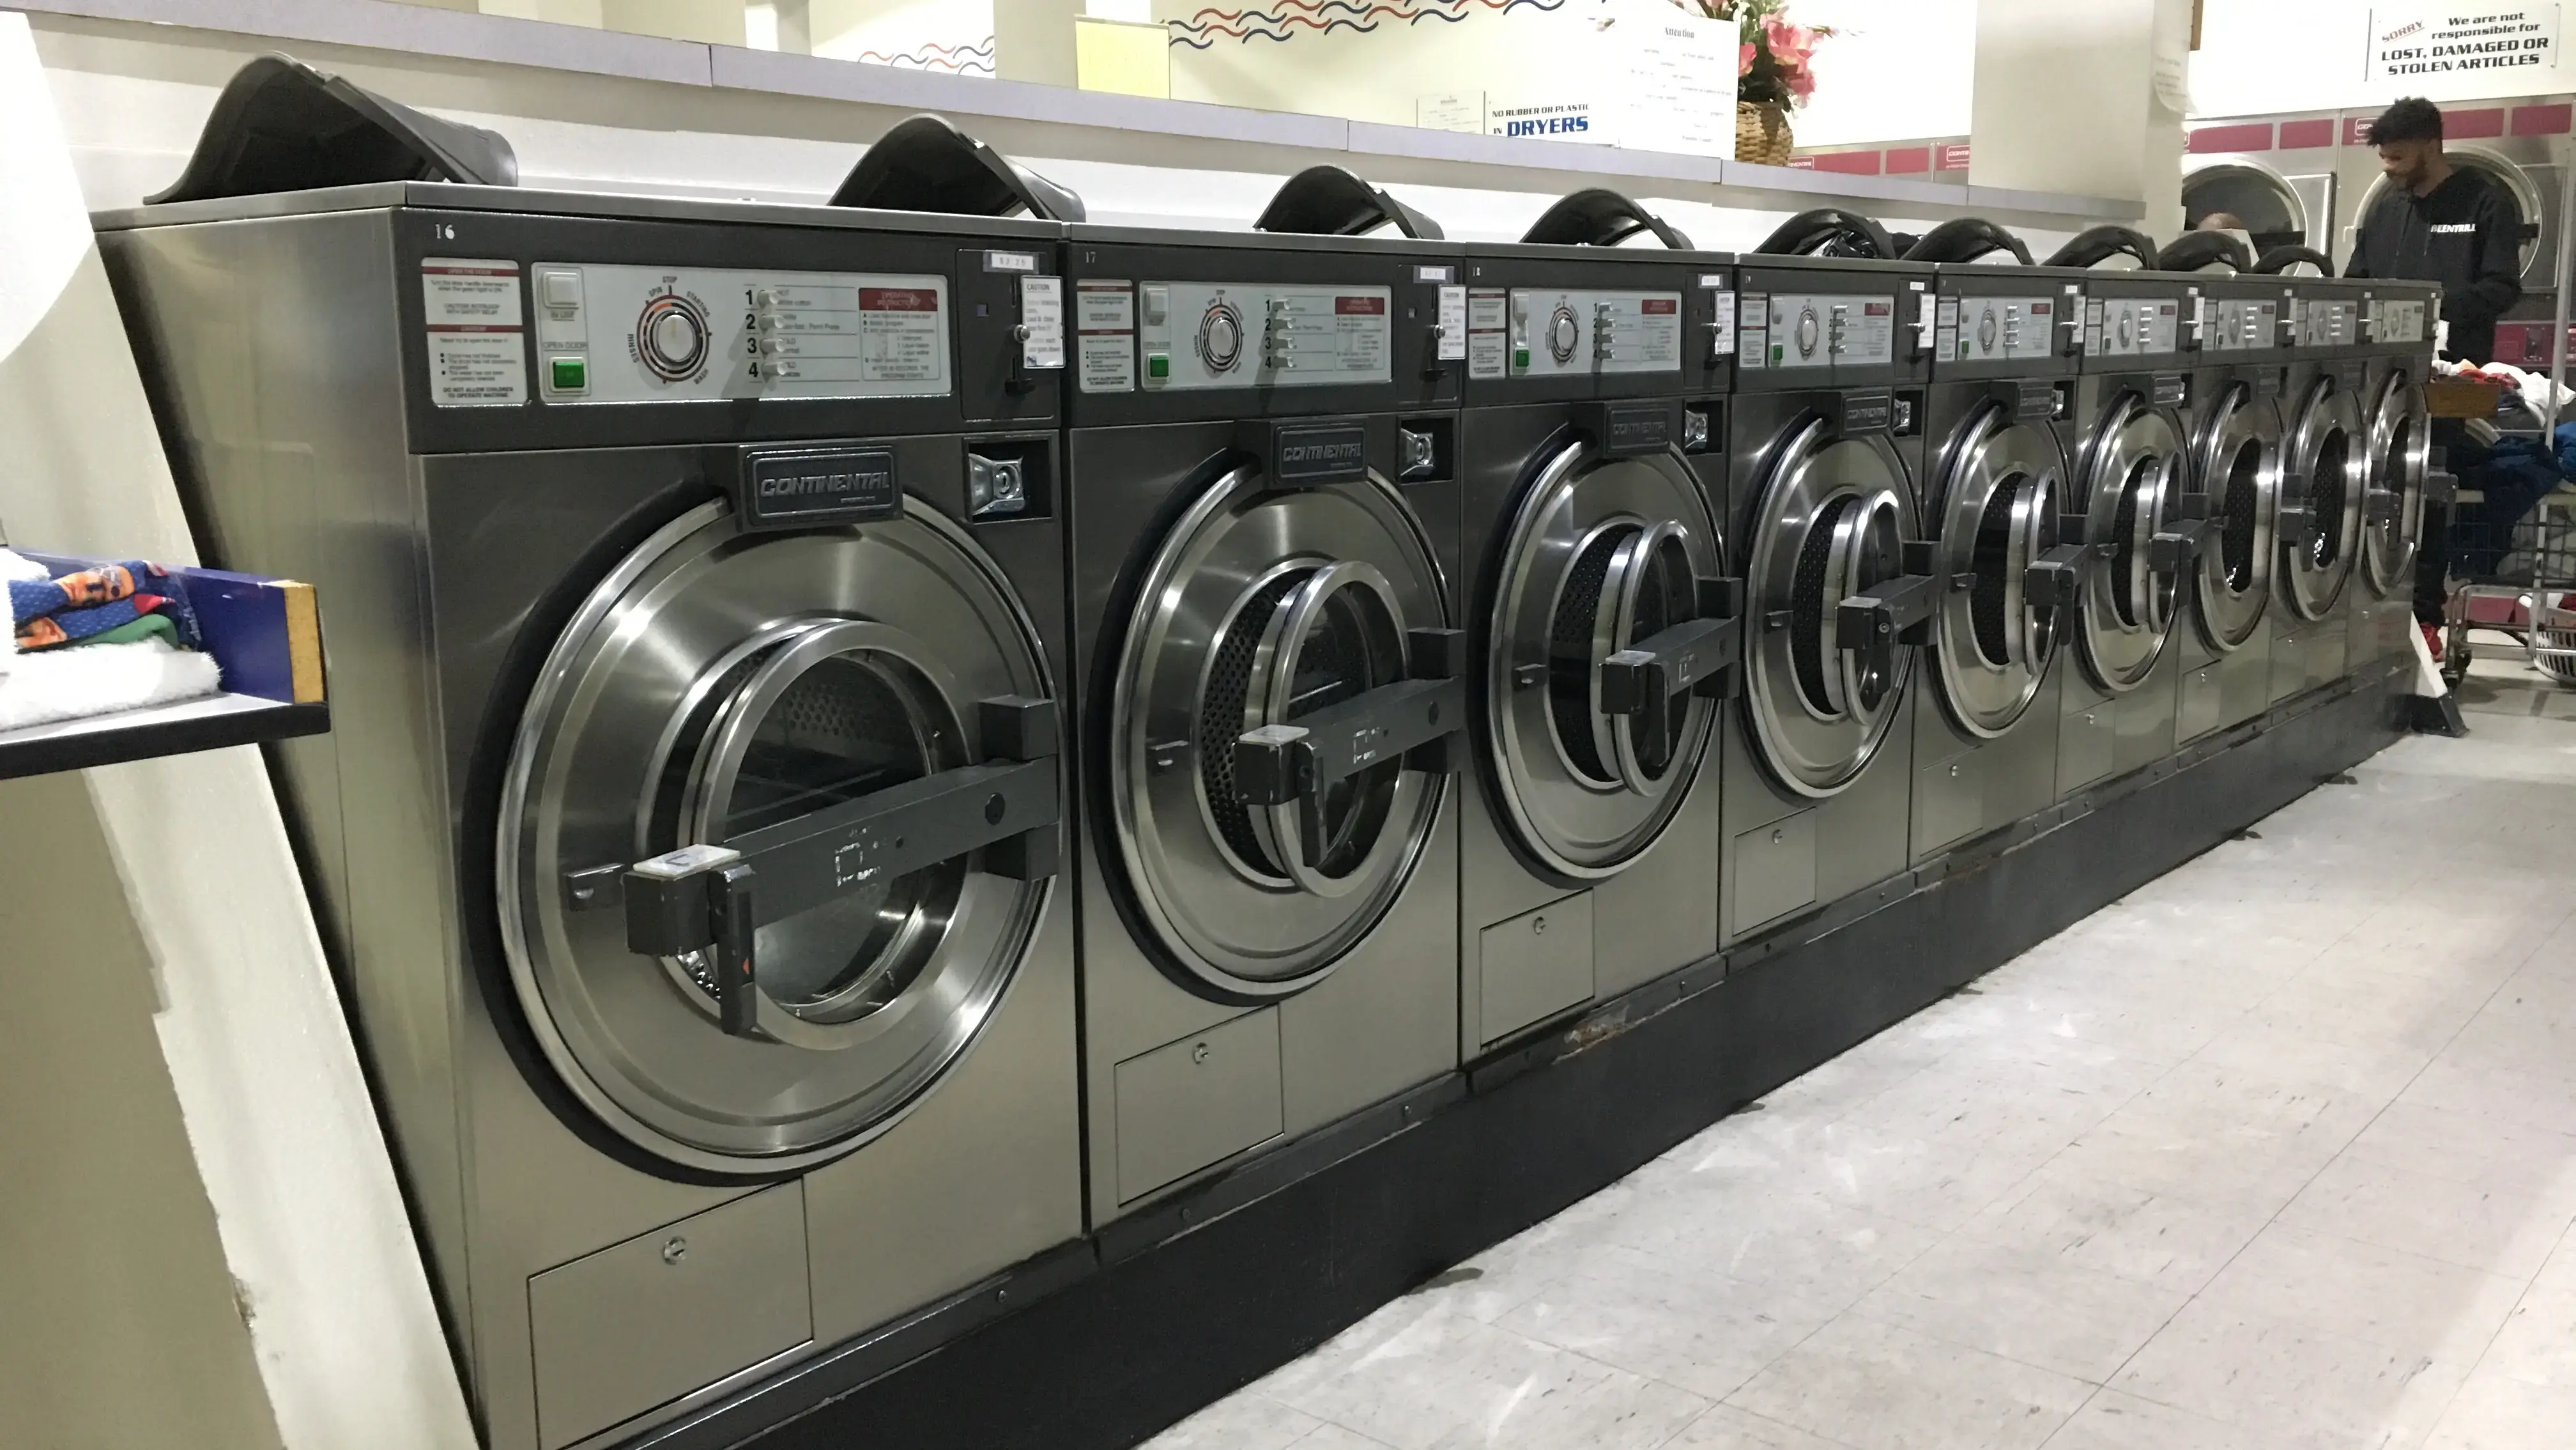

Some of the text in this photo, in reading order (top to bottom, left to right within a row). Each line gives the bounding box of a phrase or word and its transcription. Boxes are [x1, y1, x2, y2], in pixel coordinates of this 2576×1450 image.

[2448, 12, 2525, 26] We are not
[1664, 26, 1695, 38] Attention
[2382, 20, 2423, 42] SORRY
[2432, 23, 2541, 40] responsible for
[2382, 37, 2549, 61] LOST, DAMAGED OR
[2388, 54, 2540, 75] STOLEN ARTICLES
[1505, 107, 1540, 117] RUBBER
[1542, 106, 1553, 114] OR
[1555, 103, 1590, 112] PLASTIC
[1493, 116, 1588, 137] IN DRYERS
[435, 224, 455, 240] 16
[1085, 251, 1096, 263] 17
[648, 286, 663, 297] SPIN
[746, 289, 753, 305] 1
[686, 291, 710, 318] STARTING
[1265, 299, 1270, 311] 1
[746, 313, 756, 330] 2
[1265, 318, 1271, 330] 2
[627, 334, 640, 363] RINSES
[747, 337, 757, 353] 3
[1265, 337, 1271, 350] 3
[748, 362, 758, 378] 4
[1265, 357, 1271, 369] 4
[693, 369, 709, 385] WASH
[1283, 443, 1361, 462] CONTINENTAL
[760, 472, 890, 497] CONTINENTAL
